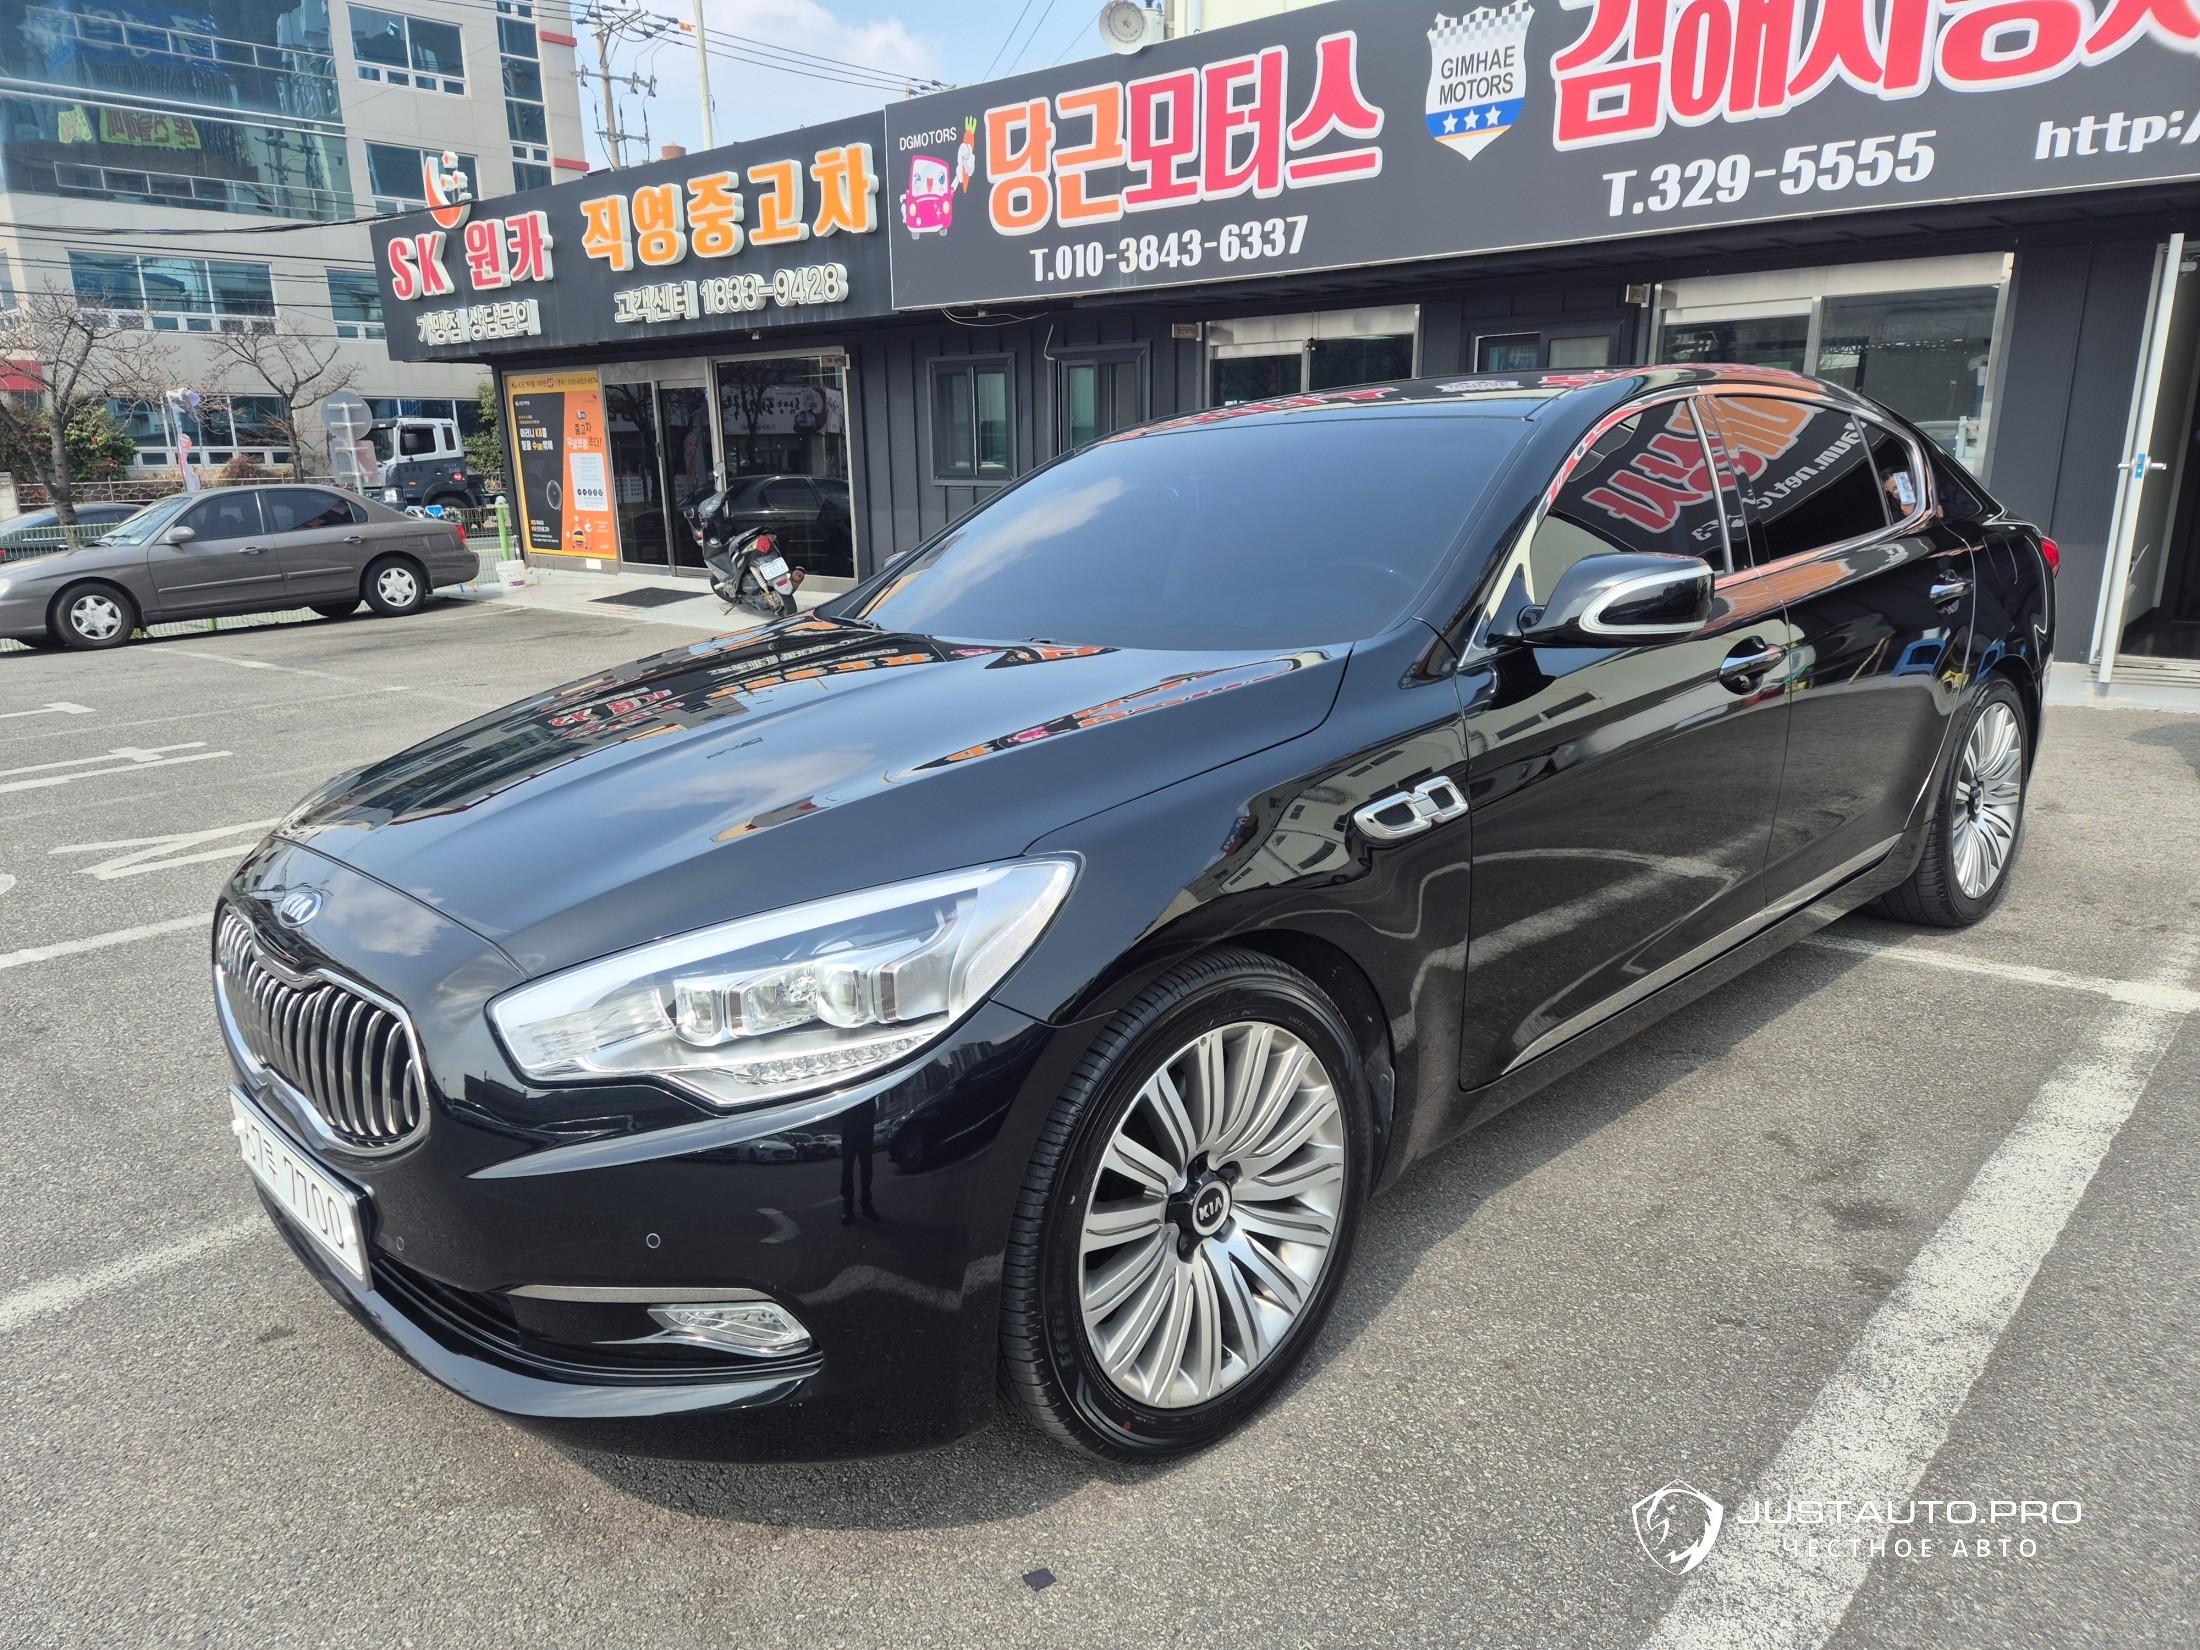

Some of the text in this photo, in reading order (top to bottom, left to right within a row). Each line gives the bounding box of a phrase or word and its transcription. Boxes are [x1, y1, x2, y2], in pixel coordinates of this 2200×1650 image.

[1439, 71, 1514, 106] MOTORS
[1441, 45, 1516, 80] GIMHAE
[899, 126, 957, 151] DGMOTORS
[984, 30, 1386, 237] 당근모터스
[580, 142, 879, 272] 직영중고차
[1602, 140, 1937, 217] T.329-5555
[388, 210, 553, 301] SK 원카
[1029, 214, 1309, 282] T.010-3843-6337
[416, 299, 541, 346] 가맹점 상담문의
[614, 262, 848, 323] 고객센터 1833-9428
[282, 1154, 345, 1250] 7700
[1199, 1196, 1223, 1221] KIA
